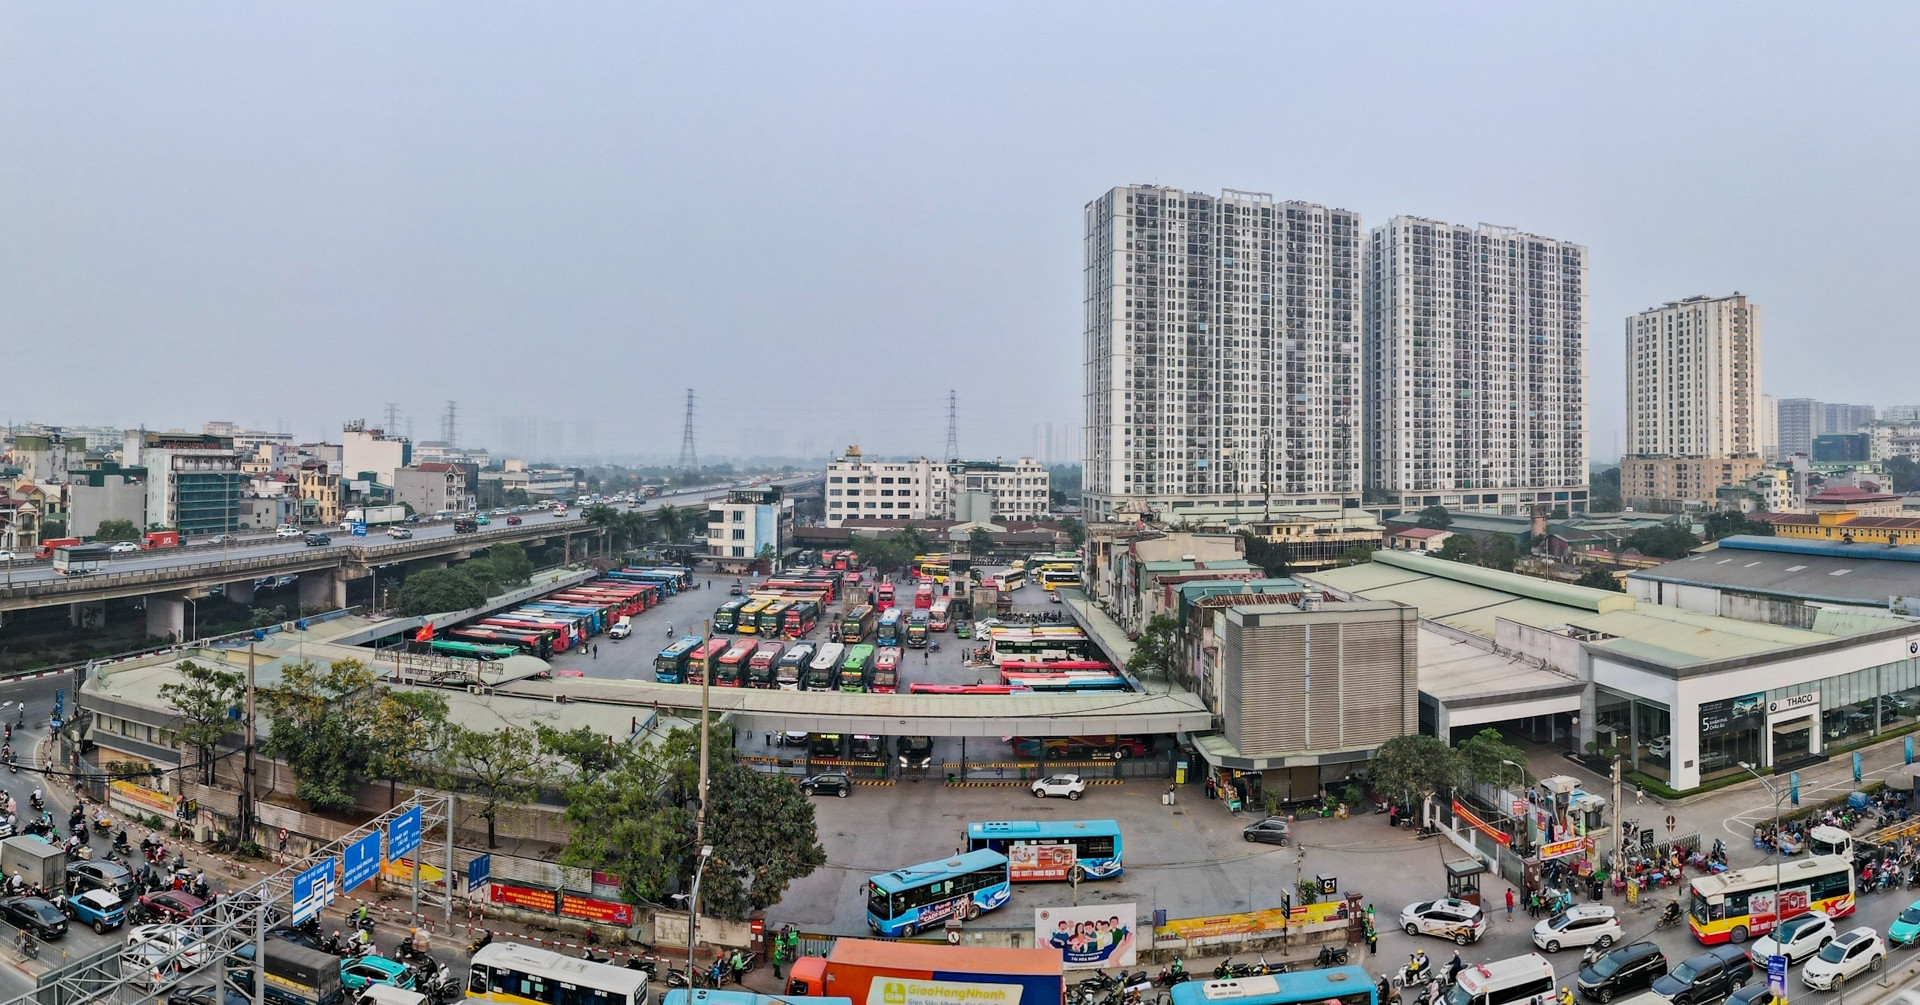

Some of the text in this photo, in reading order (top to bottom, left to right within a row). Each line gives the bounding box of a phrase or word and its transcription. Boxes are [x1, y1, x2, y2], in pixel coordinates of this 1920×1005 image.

[1787, 693, 1812, 706] THACO
[1702, 717, 1709, 731] 5
[1324, 880, 1335, 889] C1
[908, 984, 1006, 1001] GiaoHangNhanh
